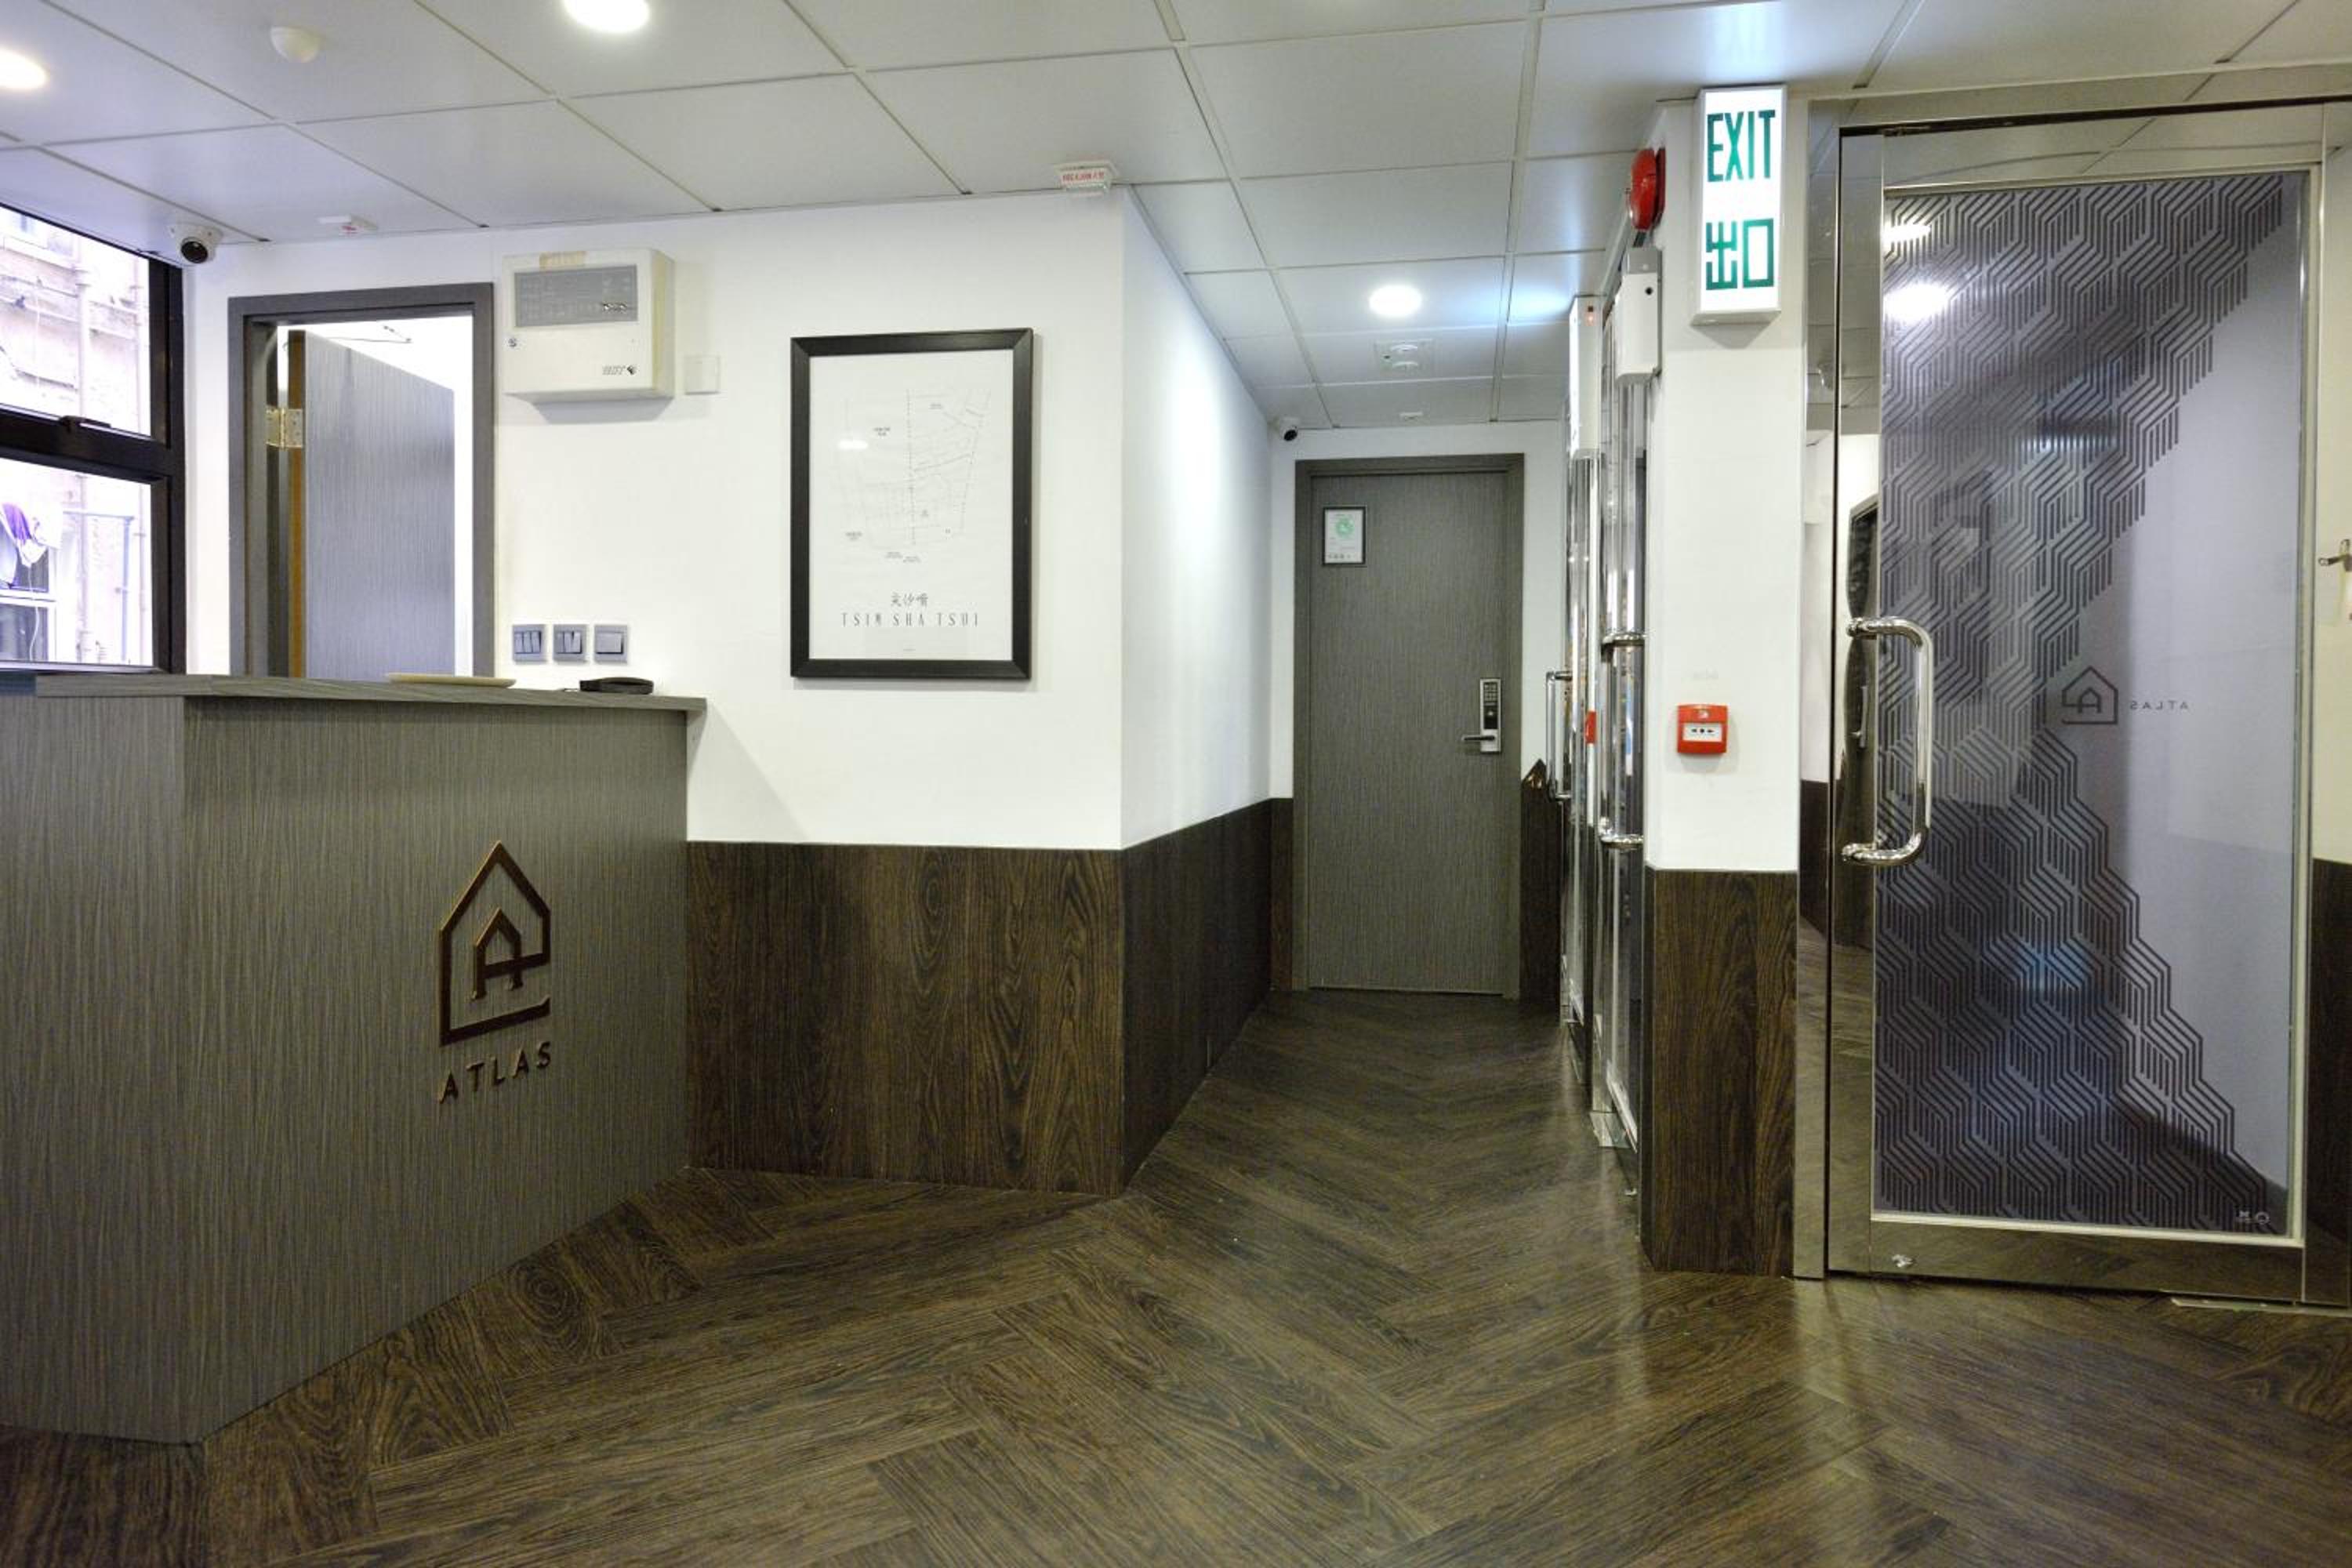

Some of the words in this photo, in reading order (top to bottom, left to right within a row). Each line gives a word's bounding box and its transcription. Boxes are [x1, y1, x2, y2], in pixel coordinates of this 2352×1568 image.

[1707, 109, 1776, 182] EXIT
[1705, 218, 1774, 290] 出口
[892, 612, 924, 627] SHA
[937, 612, 978, 627] TSUI
[439, 1041, 551, 1104] ATLAS
